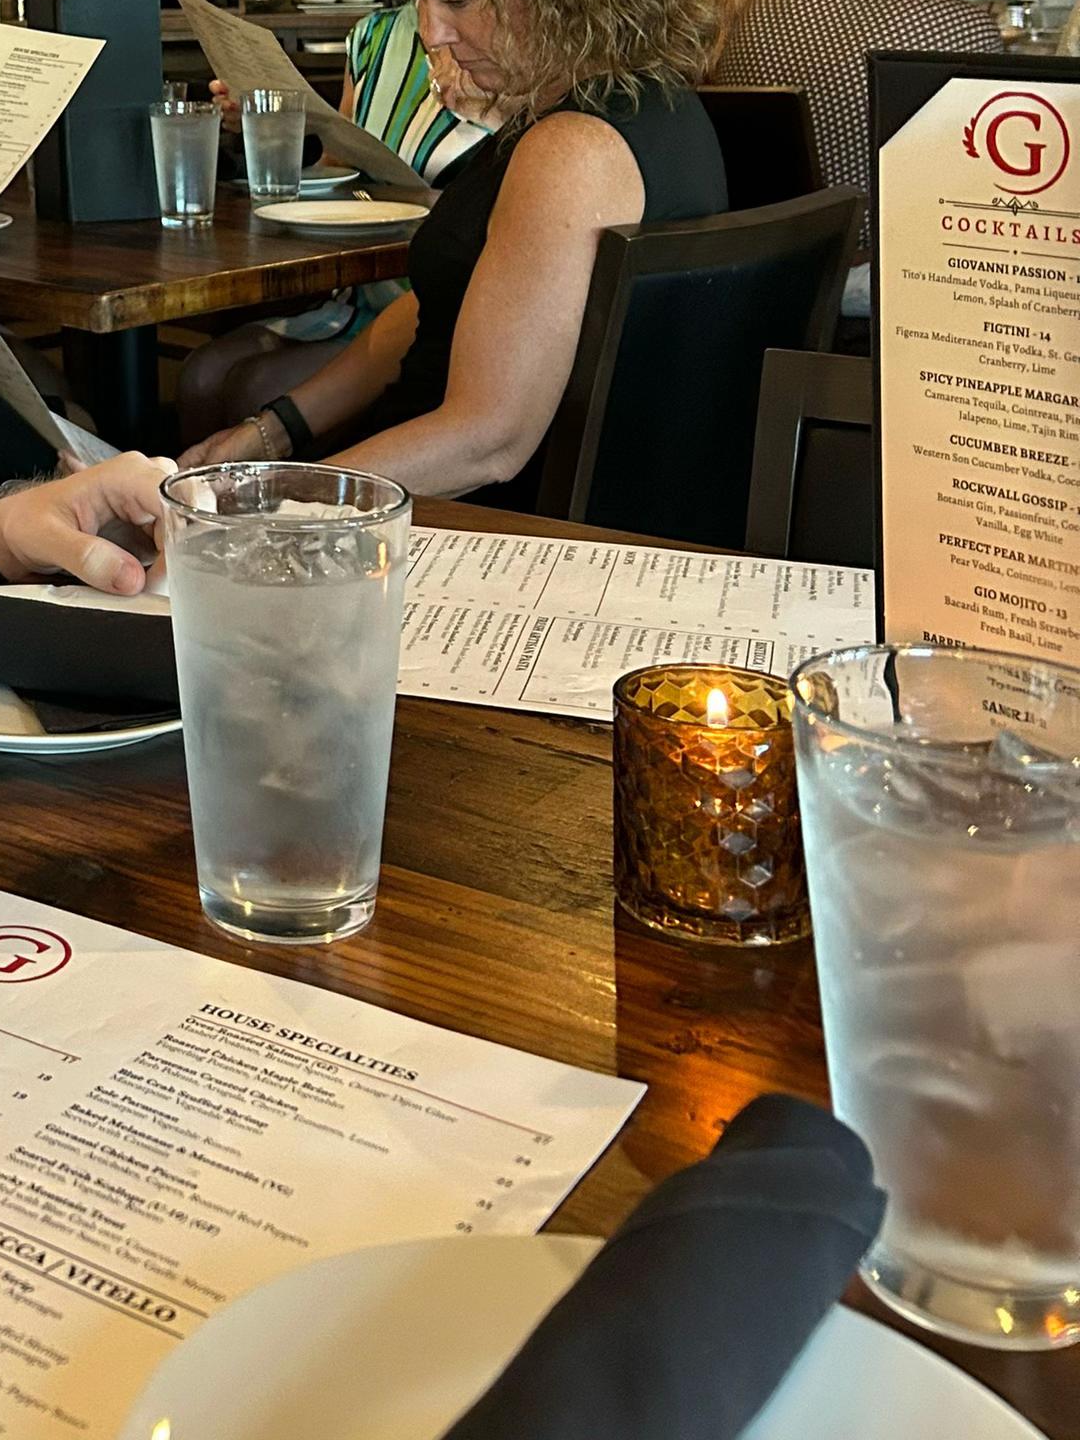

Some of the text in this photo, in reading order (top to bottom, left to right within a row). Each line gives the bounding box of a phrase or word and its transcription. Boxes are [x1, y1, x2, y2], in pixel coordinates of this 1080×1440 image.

[941, 215, 1080, 245] COCKTAILS
[901, 268, 927, 281] Tito's
[928, 272, 978, 288] Handmade
[978, 278, 1013, 294] Vodka,
[1014, 282, 1041, 297] Pama
[947, 257, 1066, 282] GIOVANNI PASSION
[952, 290, 988, 306] Lemon,
[988, 295, 1021, 310] Splash
[1021, 299, 1034, 312] of
[895, 325, 930, 340] Figenza
[931, 331, 994, 350] Mediteranean
[996, 340, 1011, 355] Fig
[1011, 343, 1047, 359] Vodka,
[1047, 348, 1062, 361] St.
[983, 321, 1051, 343] FIGTINI 14
[978, 354, 1056, 376] Cranberry, Lime
[919, 370, 1080, 410] SPICY PINEAPPLE MARGAR
[924, 388, 1080, 427] Camarena Tequila, Cointreau, Pin
[958, 410, 1080, 442] Jalapeno, Lime, Tajin Rim
[912, 444, 951, 461] Western
[951, 452, 970, 465] Son
[970, 456, 1021, 475] Cucumber
[1021, 465, 1056, 484] Vodka,
[949, 434, 1070, 467] CUCUMBER BREEZE
[936, 491, 1060, 530] Botanist Gin, Passionfruit,
[952, 477, 1068, 512] ROCKWALL GOSSIP
[974, 515, 1064, 546] Vanilla, Egg White
[939, 533, 1080, 579] PERFECT PEAR MARTIN
[950, 553, 971, 567] Pear
[971, 558, 1005, 577] Vodka,
[944, 595, 1080, 642] Bacardi Rum, Fresh Strawbe
[973, 585, 1068, 621] GIO MOJITO 13
[980, 620, 1064, 653] Fresh Basil, Lime
[199, 1003, 419, 1081] HOUSE SPECIALTIES
[37, 1073, 53, 1082] 18
[67, 1264, 177, 1323] VITELLO
